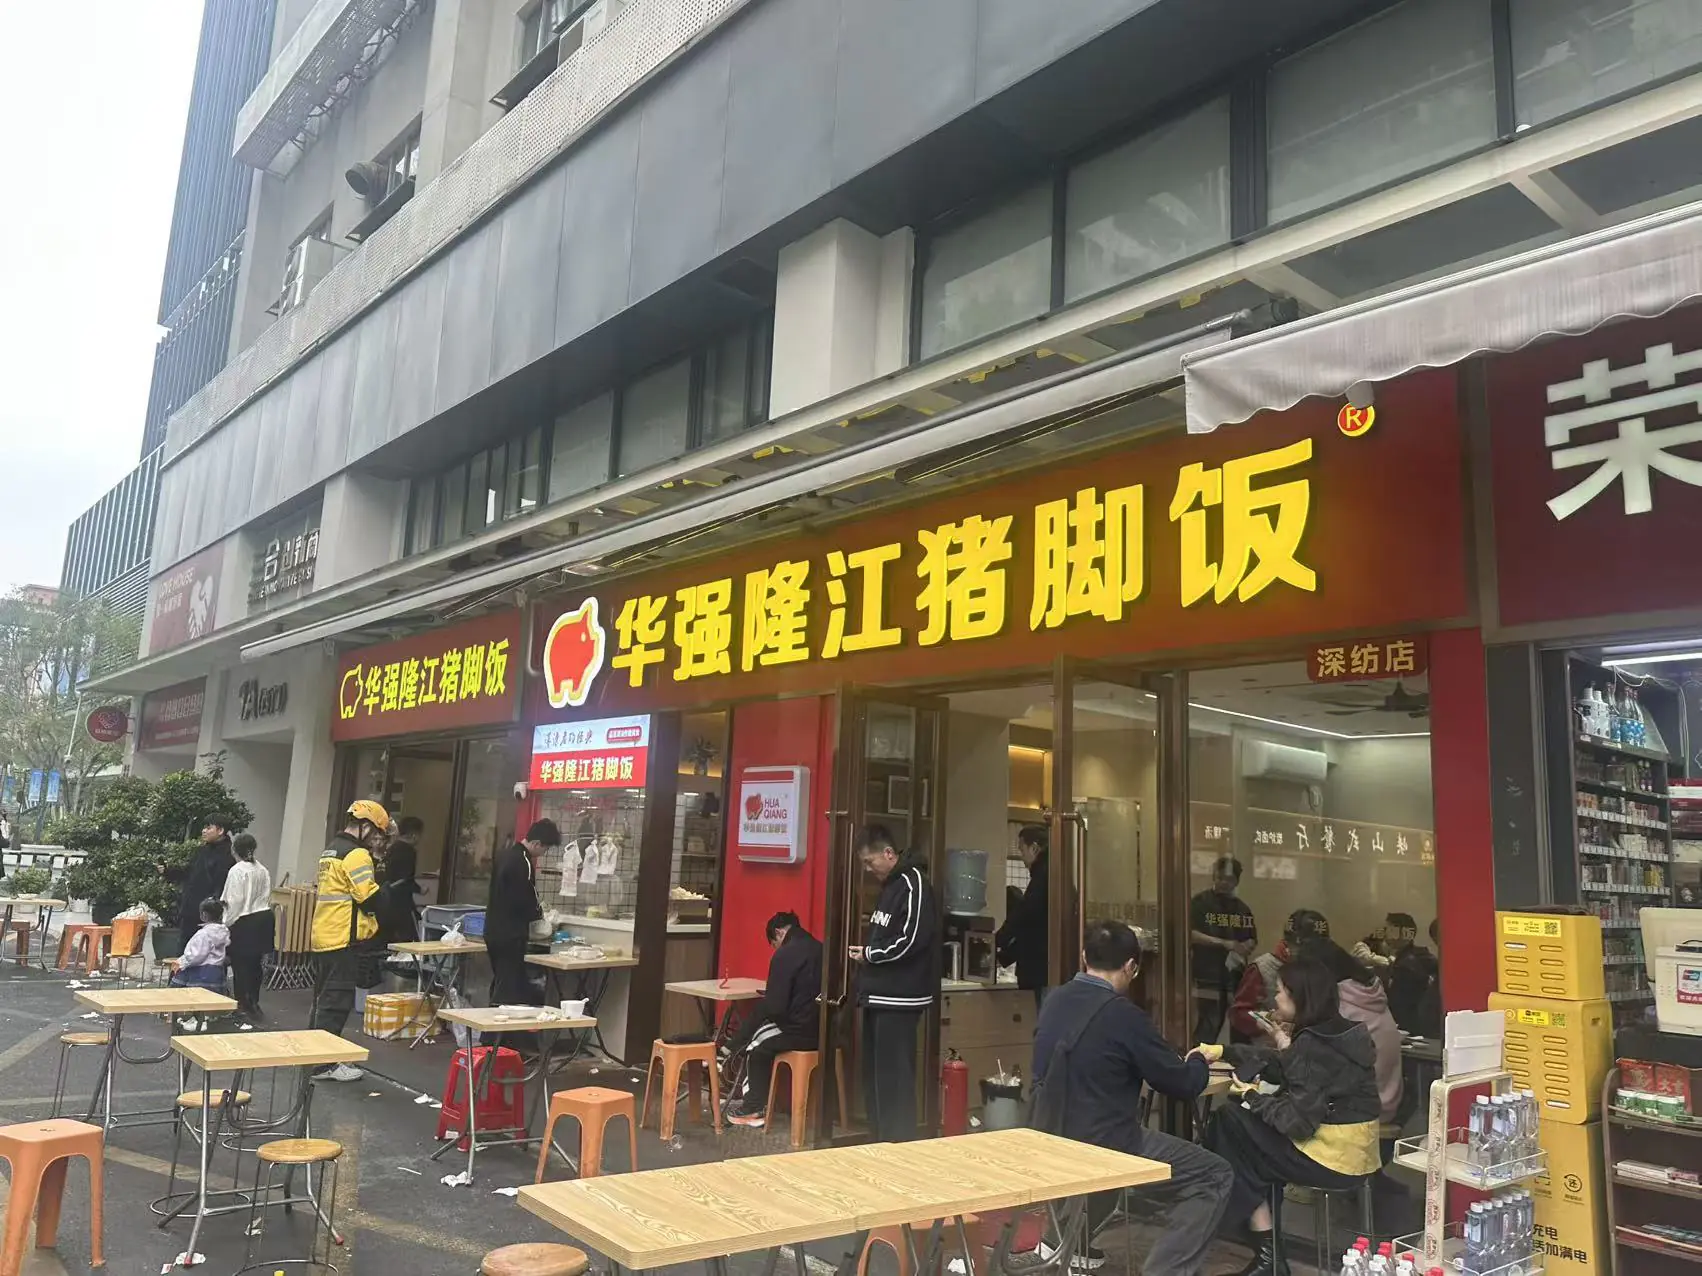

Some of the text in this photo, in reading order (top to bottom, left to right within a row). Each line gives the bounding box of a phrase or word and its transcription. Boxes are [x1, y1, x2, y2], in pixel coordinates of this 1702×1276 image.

[1544, 342, 1702, 521] 荣
[611, 437, 1317, 688] 华强隆江猪脚饭
[363, 638, 509, 716] 华强隆江猪脚饭
[1317, 640, 1415, 677] 深纺店
[540, 755, 634, 784] 华强隆江猪脚饭
[764, 797, 780, 809] HUA
[764, 808, 788, 820] QIANG
